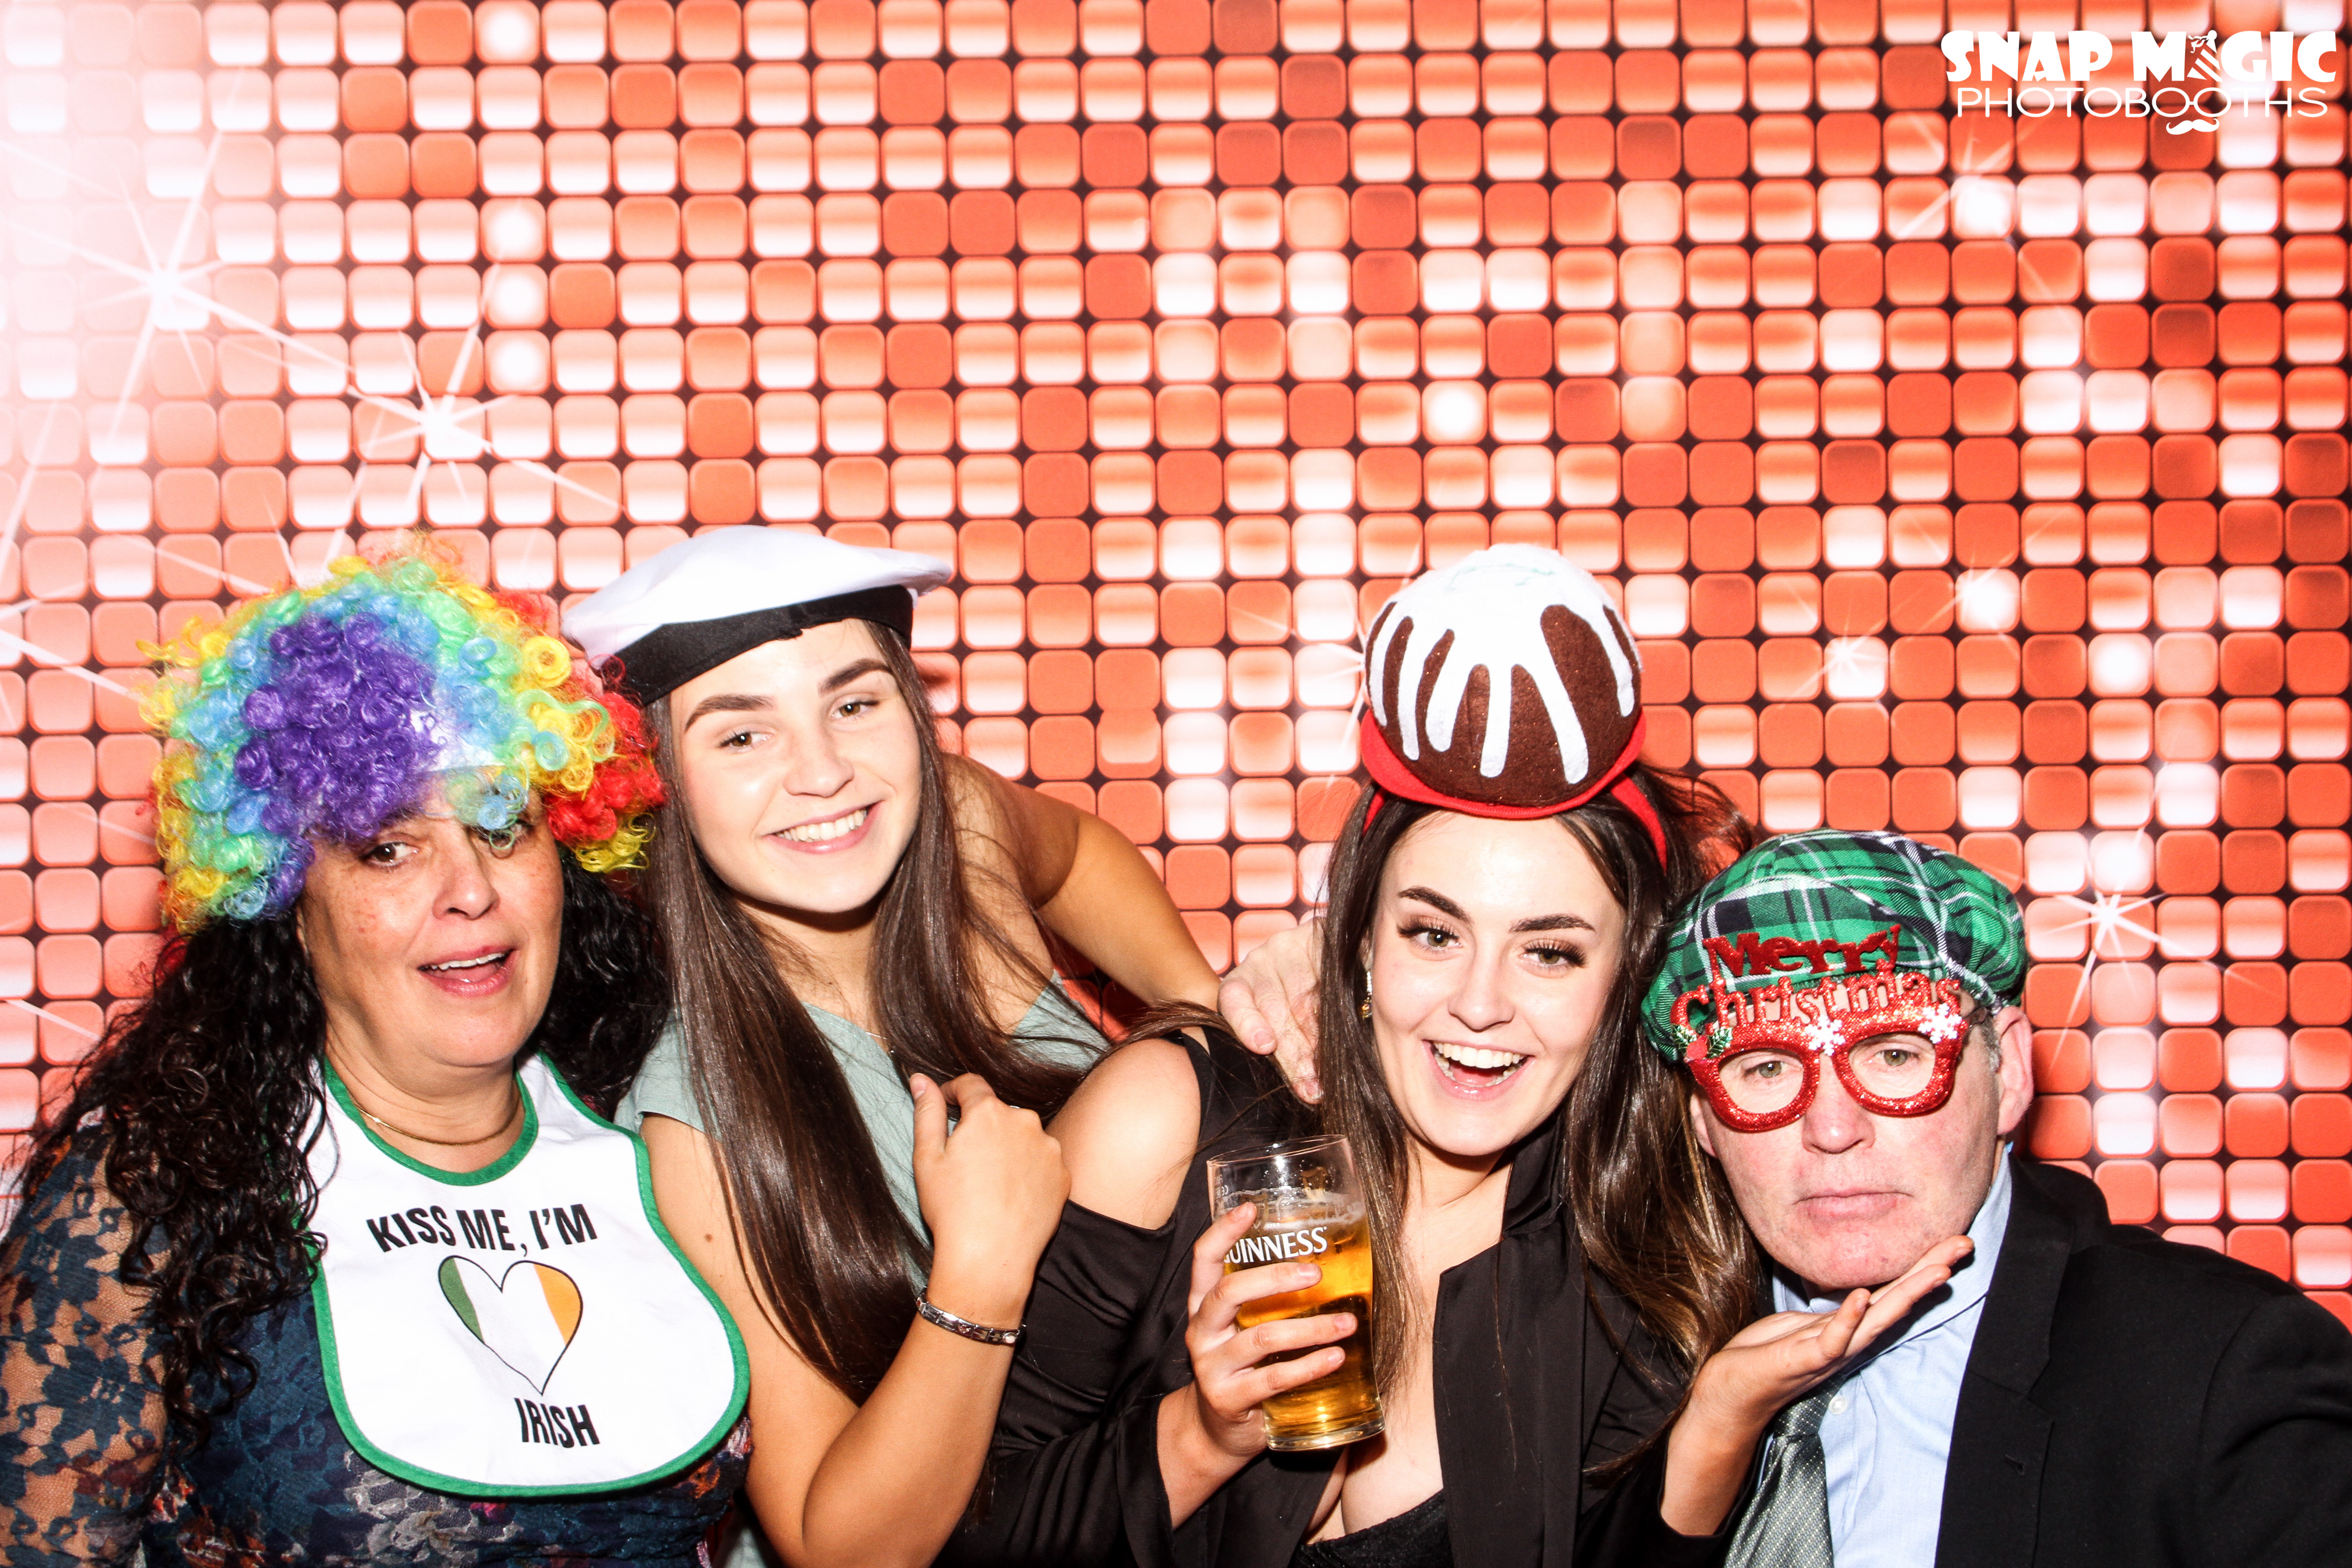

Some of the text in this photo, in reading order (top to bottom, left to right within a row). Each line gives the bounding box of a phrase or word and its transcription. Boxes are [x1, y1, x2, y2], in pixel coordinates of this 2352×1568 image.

[1702, 924, 1901, 977] Merry
[366, 1203, 598, 1257] KISS ME, I'M
[514, 1398, 600, 1448] IRISH
